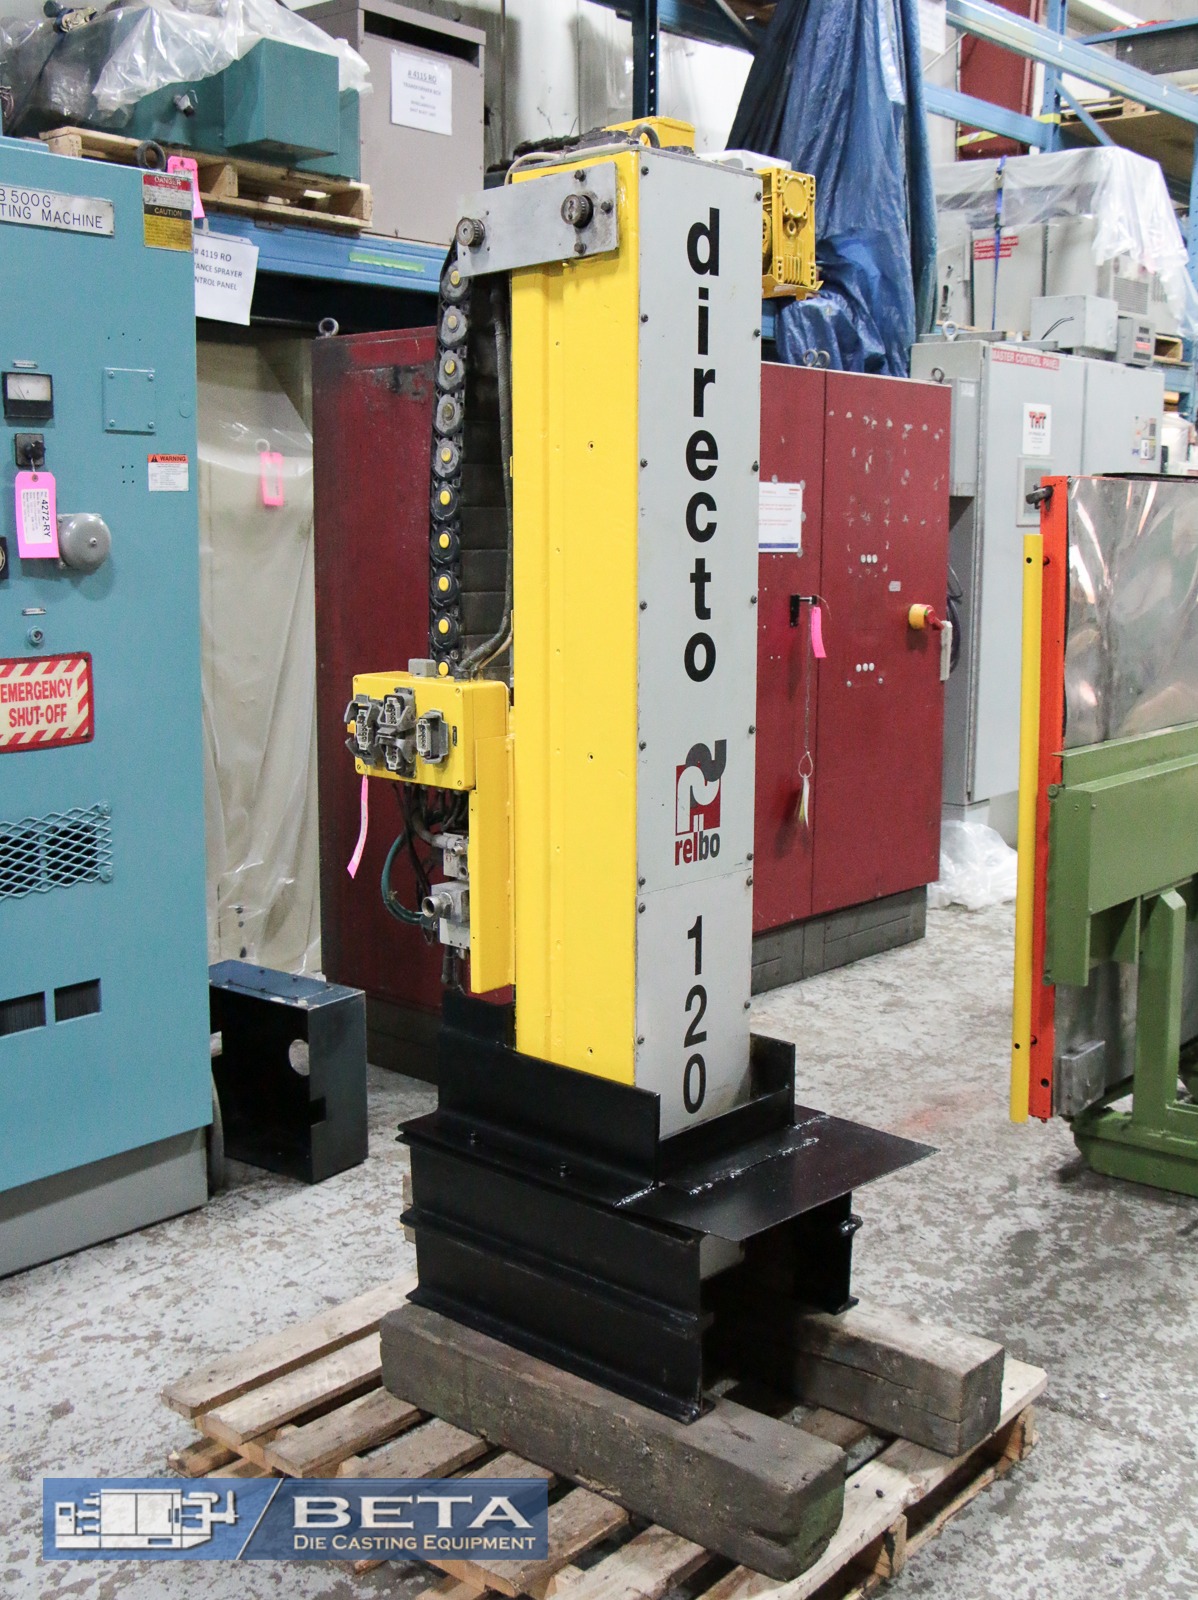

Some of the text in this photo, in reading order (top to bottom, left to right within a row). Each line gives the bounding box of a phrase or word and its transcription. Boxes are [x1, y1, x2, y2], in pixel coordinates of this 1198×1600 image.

[41, 209, 103, 229] MACHINE
[154, 207, 183, 218] CAUTION
[200, 249, 219, 260] 4119
[220, 252, 232, 262] RO
[194, 262, 243, 278] ANCE SPRAYER
[216, 281, 237, 291] PANEL
[992, 350, 1014, 363] MASTER
[1015, 352, 1041, 367] CONTROL
[41, 499, 51, 537] 4272-RY
[0, 678, 73, 703] EMERGENCY
[9, 703, 67, 728] SHUT-OFF
[674, 830, 720, 866] relbo
[683, 914, 708, 1114] 120
